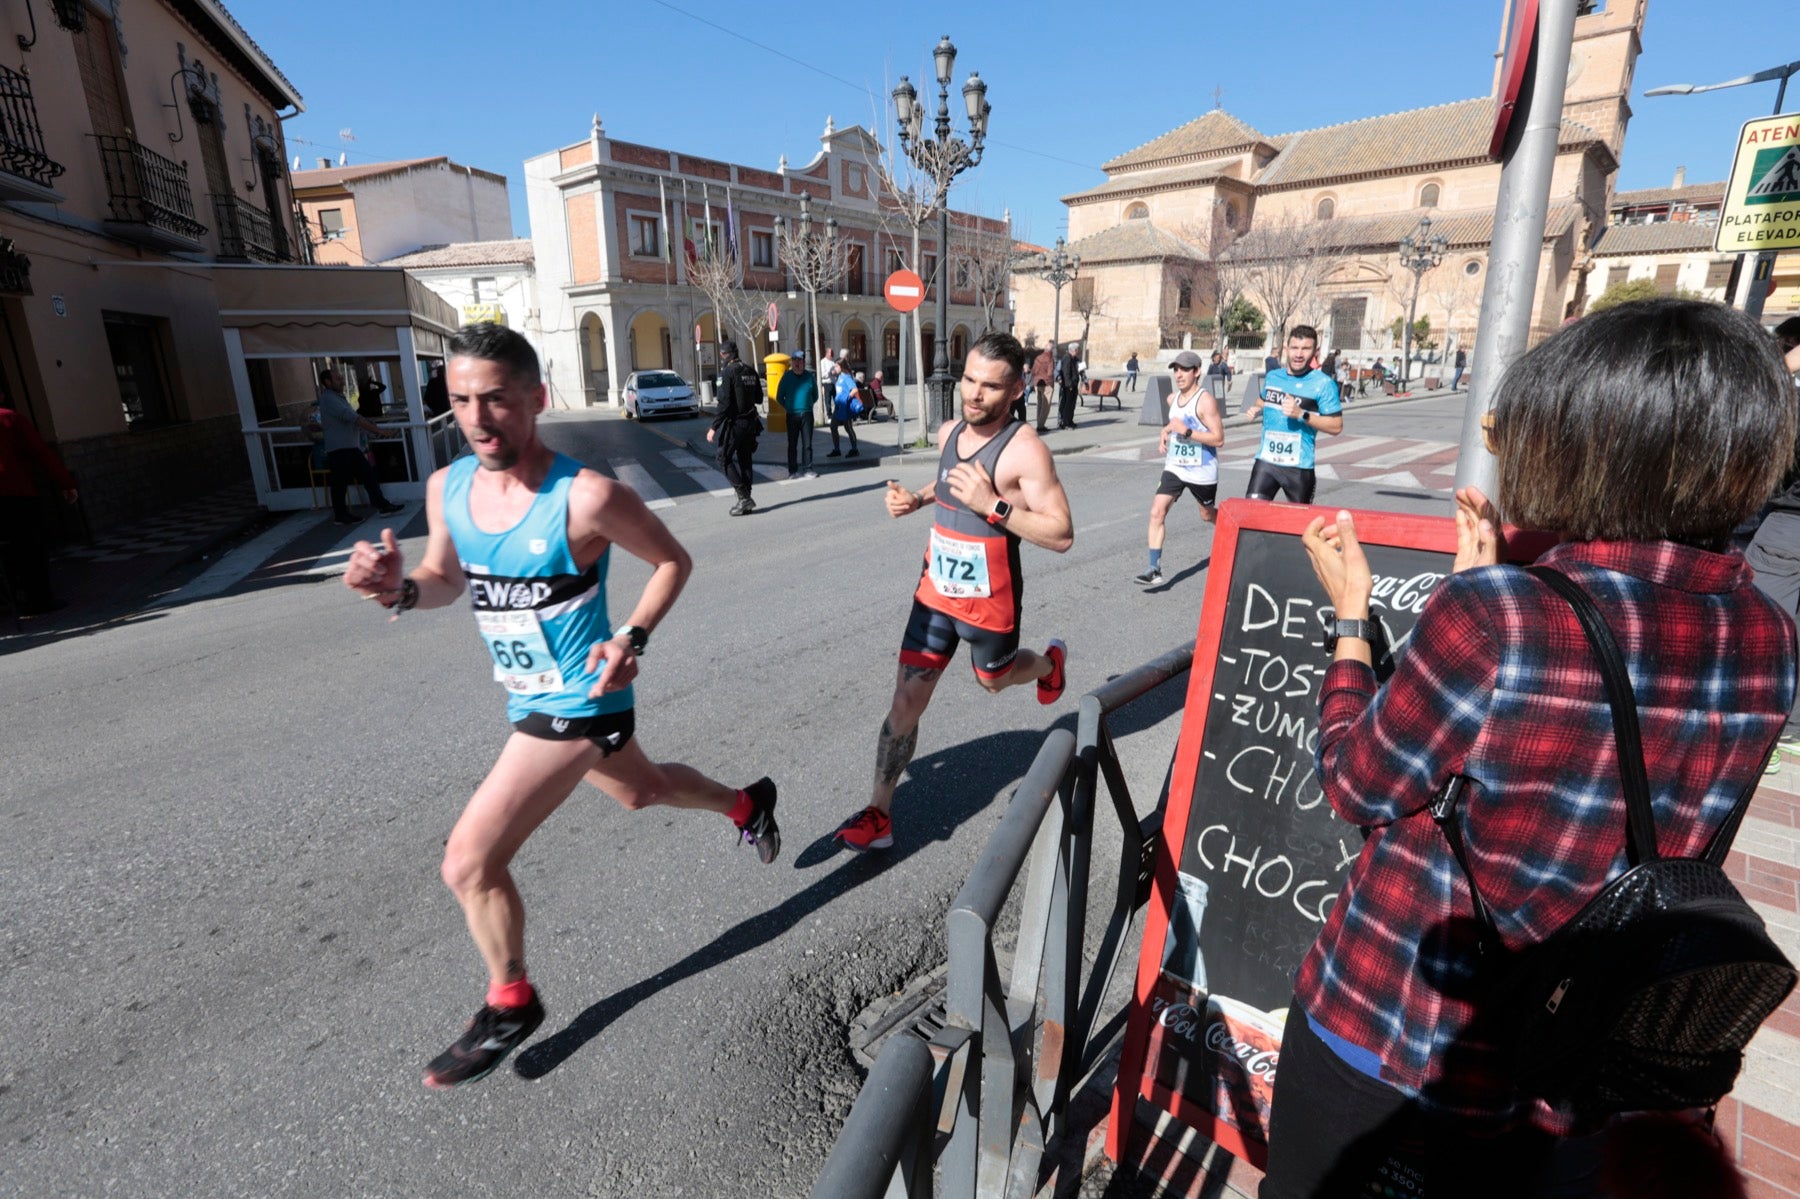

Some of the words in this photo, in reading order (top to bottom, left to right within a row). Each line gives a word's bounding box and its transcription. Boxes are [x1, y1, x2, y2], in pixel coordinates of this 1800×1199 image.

[1746, 124, 1800, 144] ATEN
[1725, 210, 1800, 227] PLATAFOR
[1174, 444, 1196, 457] 783
[1269, 440, 1293, 455] 994
[937, 554, 976, 581] 172
[493, 639, 534, 670] 66
